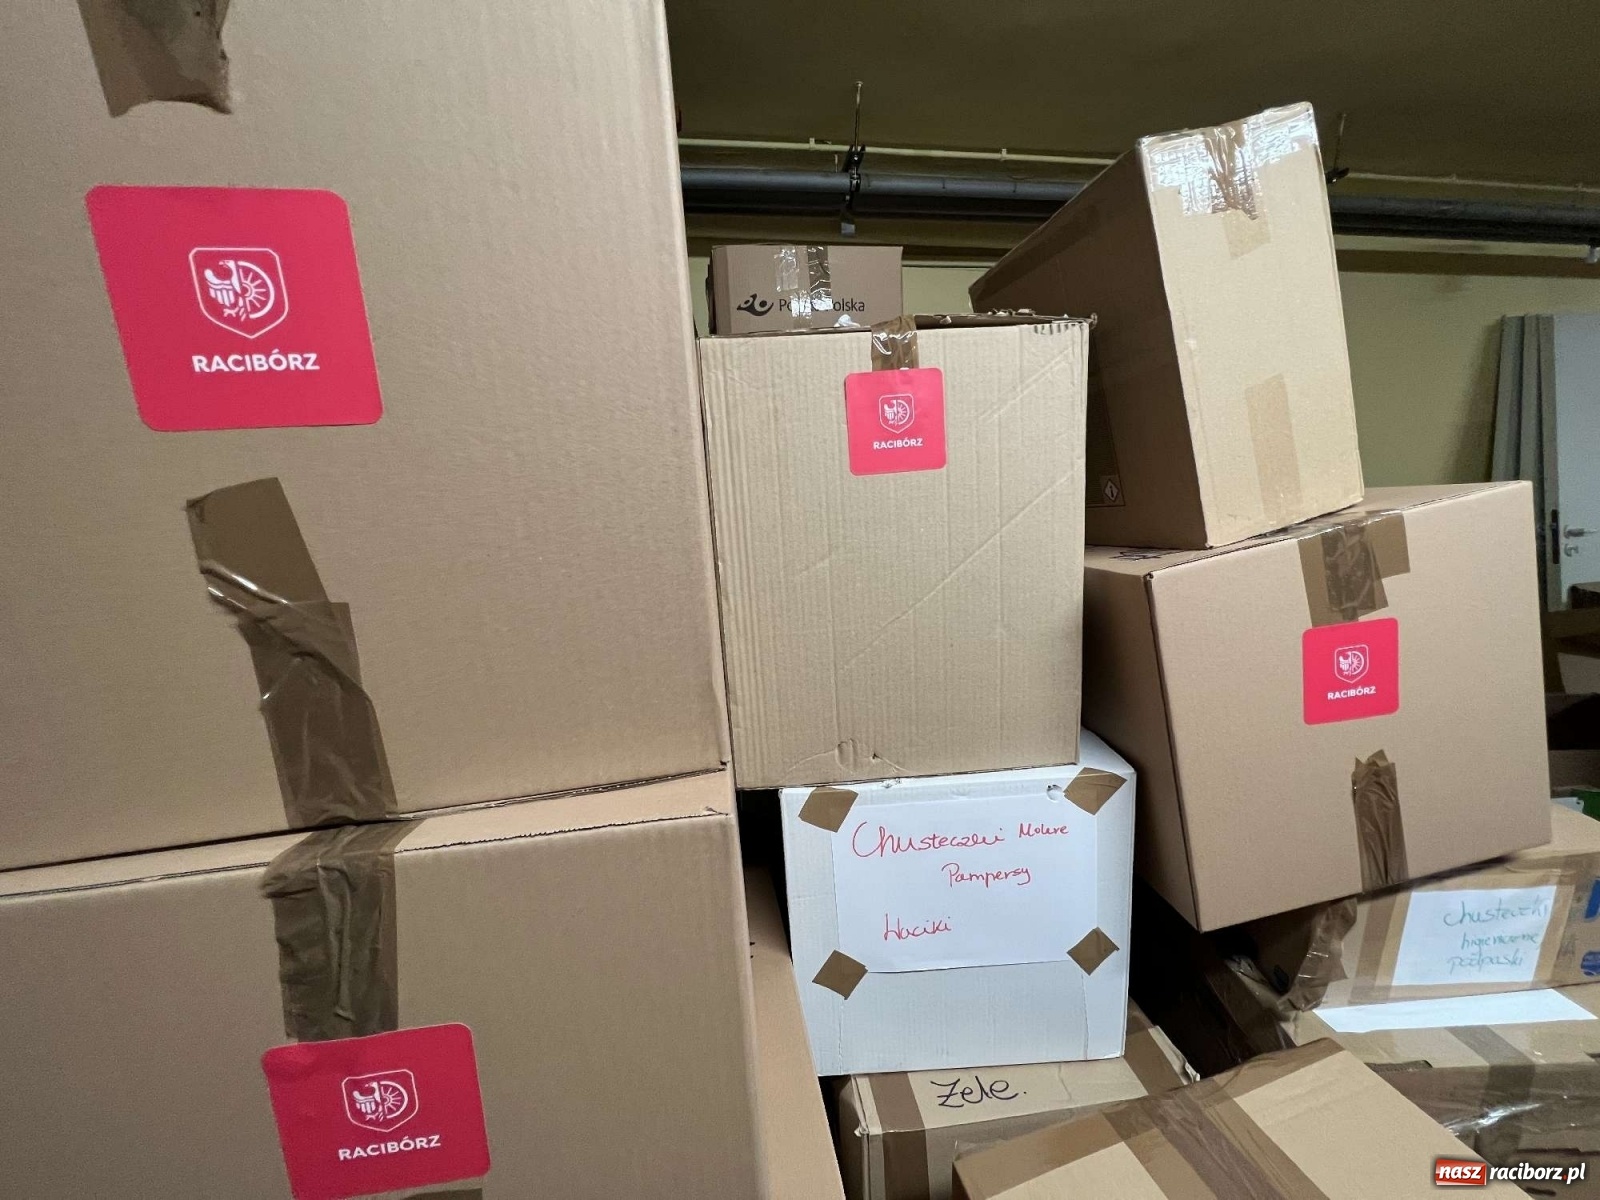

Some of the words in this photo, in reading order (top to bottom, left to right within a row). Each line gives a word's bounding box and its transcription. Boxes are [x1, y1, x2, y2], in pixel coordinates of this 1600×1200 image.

[828, 298, 866, 312] olska
[191, 348, 321, 373] RACIBÓRZ
[873, 436, 924, 450] RACIBÓRZ
[1327, 685, 1377, 701] RACIBÓRZ
[941, 862, 1032, 888] Pampersy
[337, 1134, 442, 1161] RACIBÓRZ
